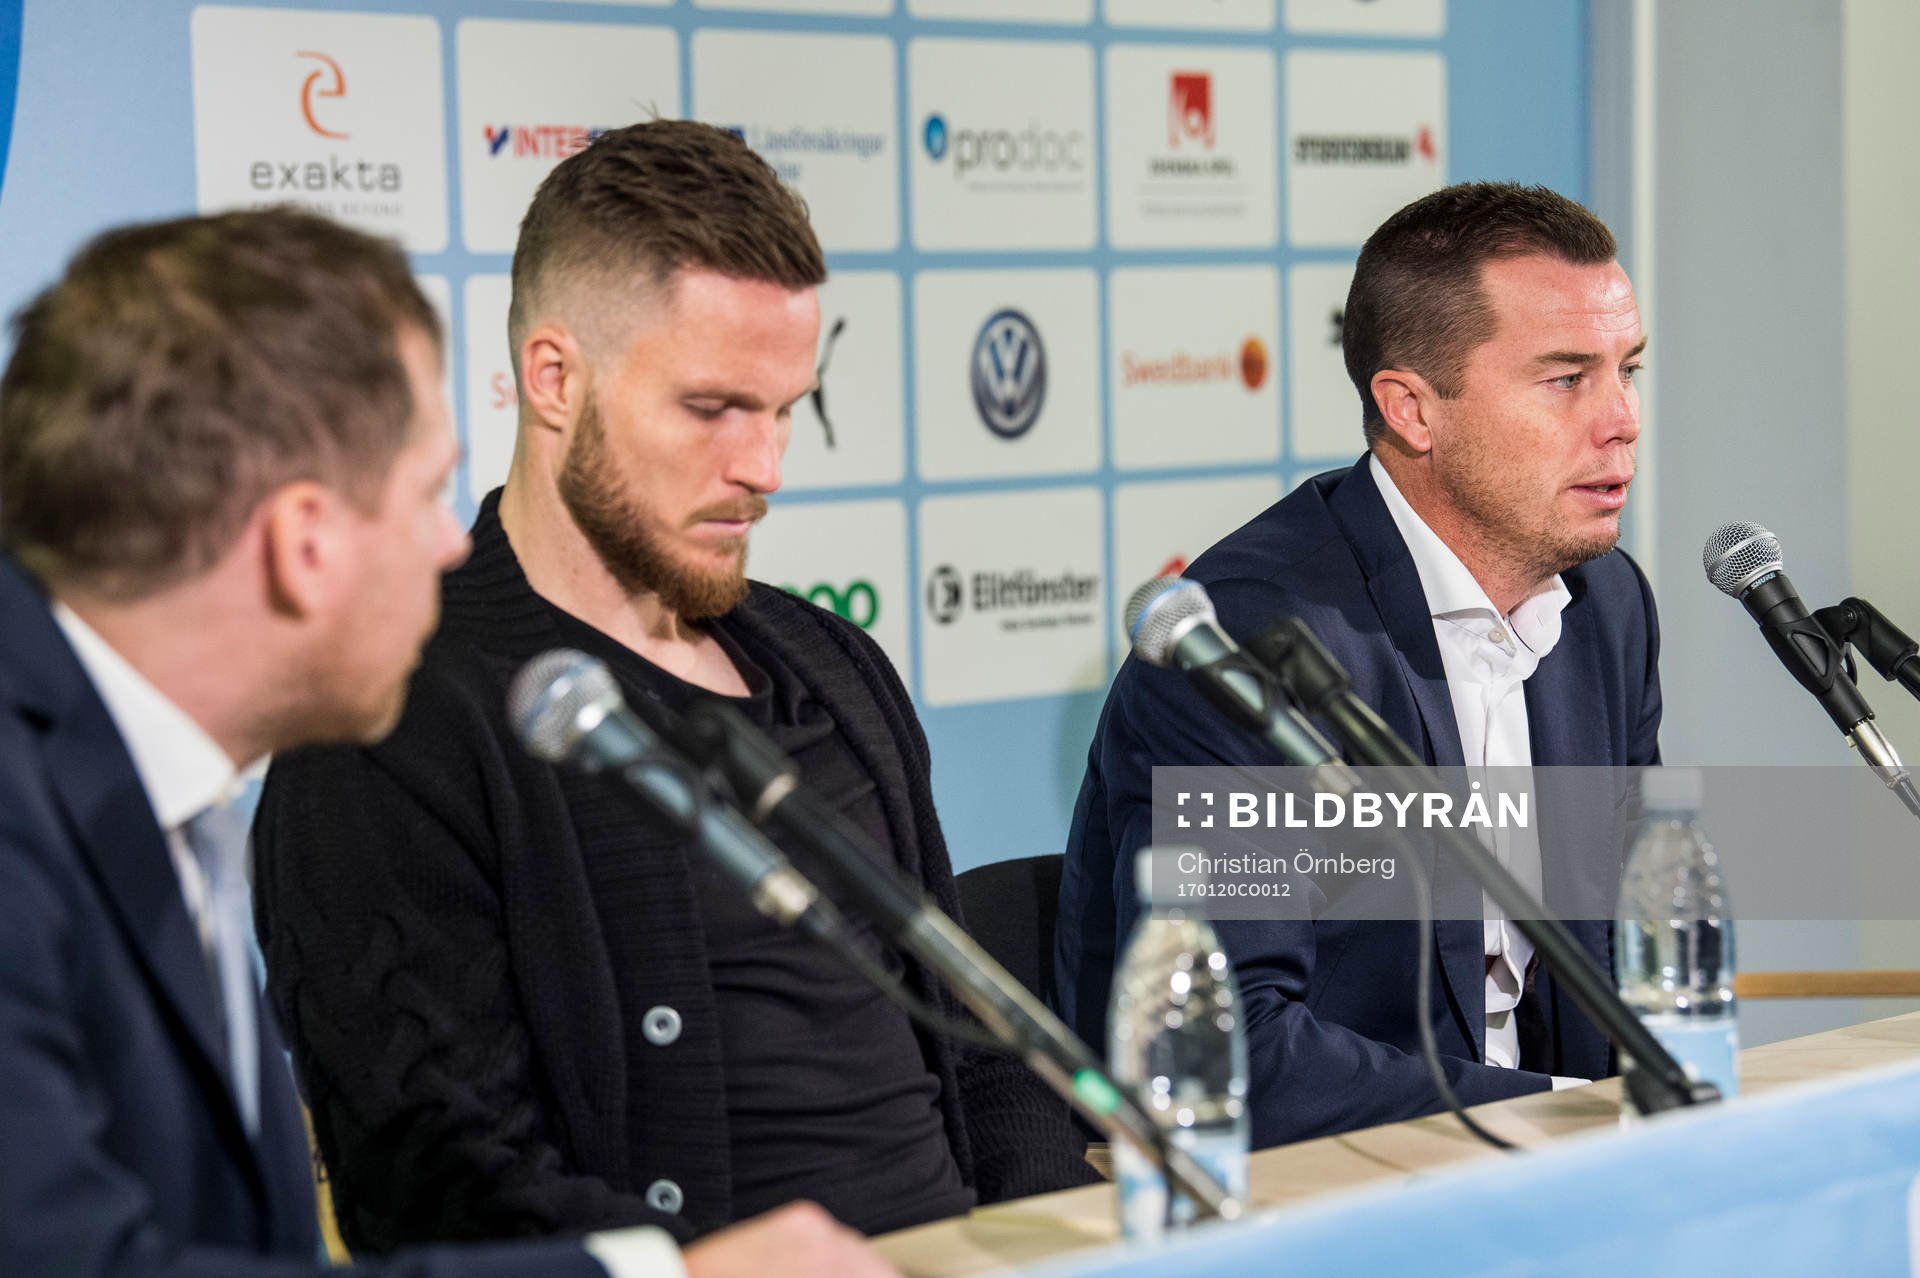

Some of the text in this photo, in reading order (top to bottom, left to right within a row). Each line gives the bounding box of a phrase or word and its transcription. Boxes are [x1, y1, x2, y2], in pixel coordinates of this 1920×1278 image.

[953, 118, 1085, 181] prodoc
[250, 153, 402, 193] exakta
[1750, 571, 1777, 591] SHURE
